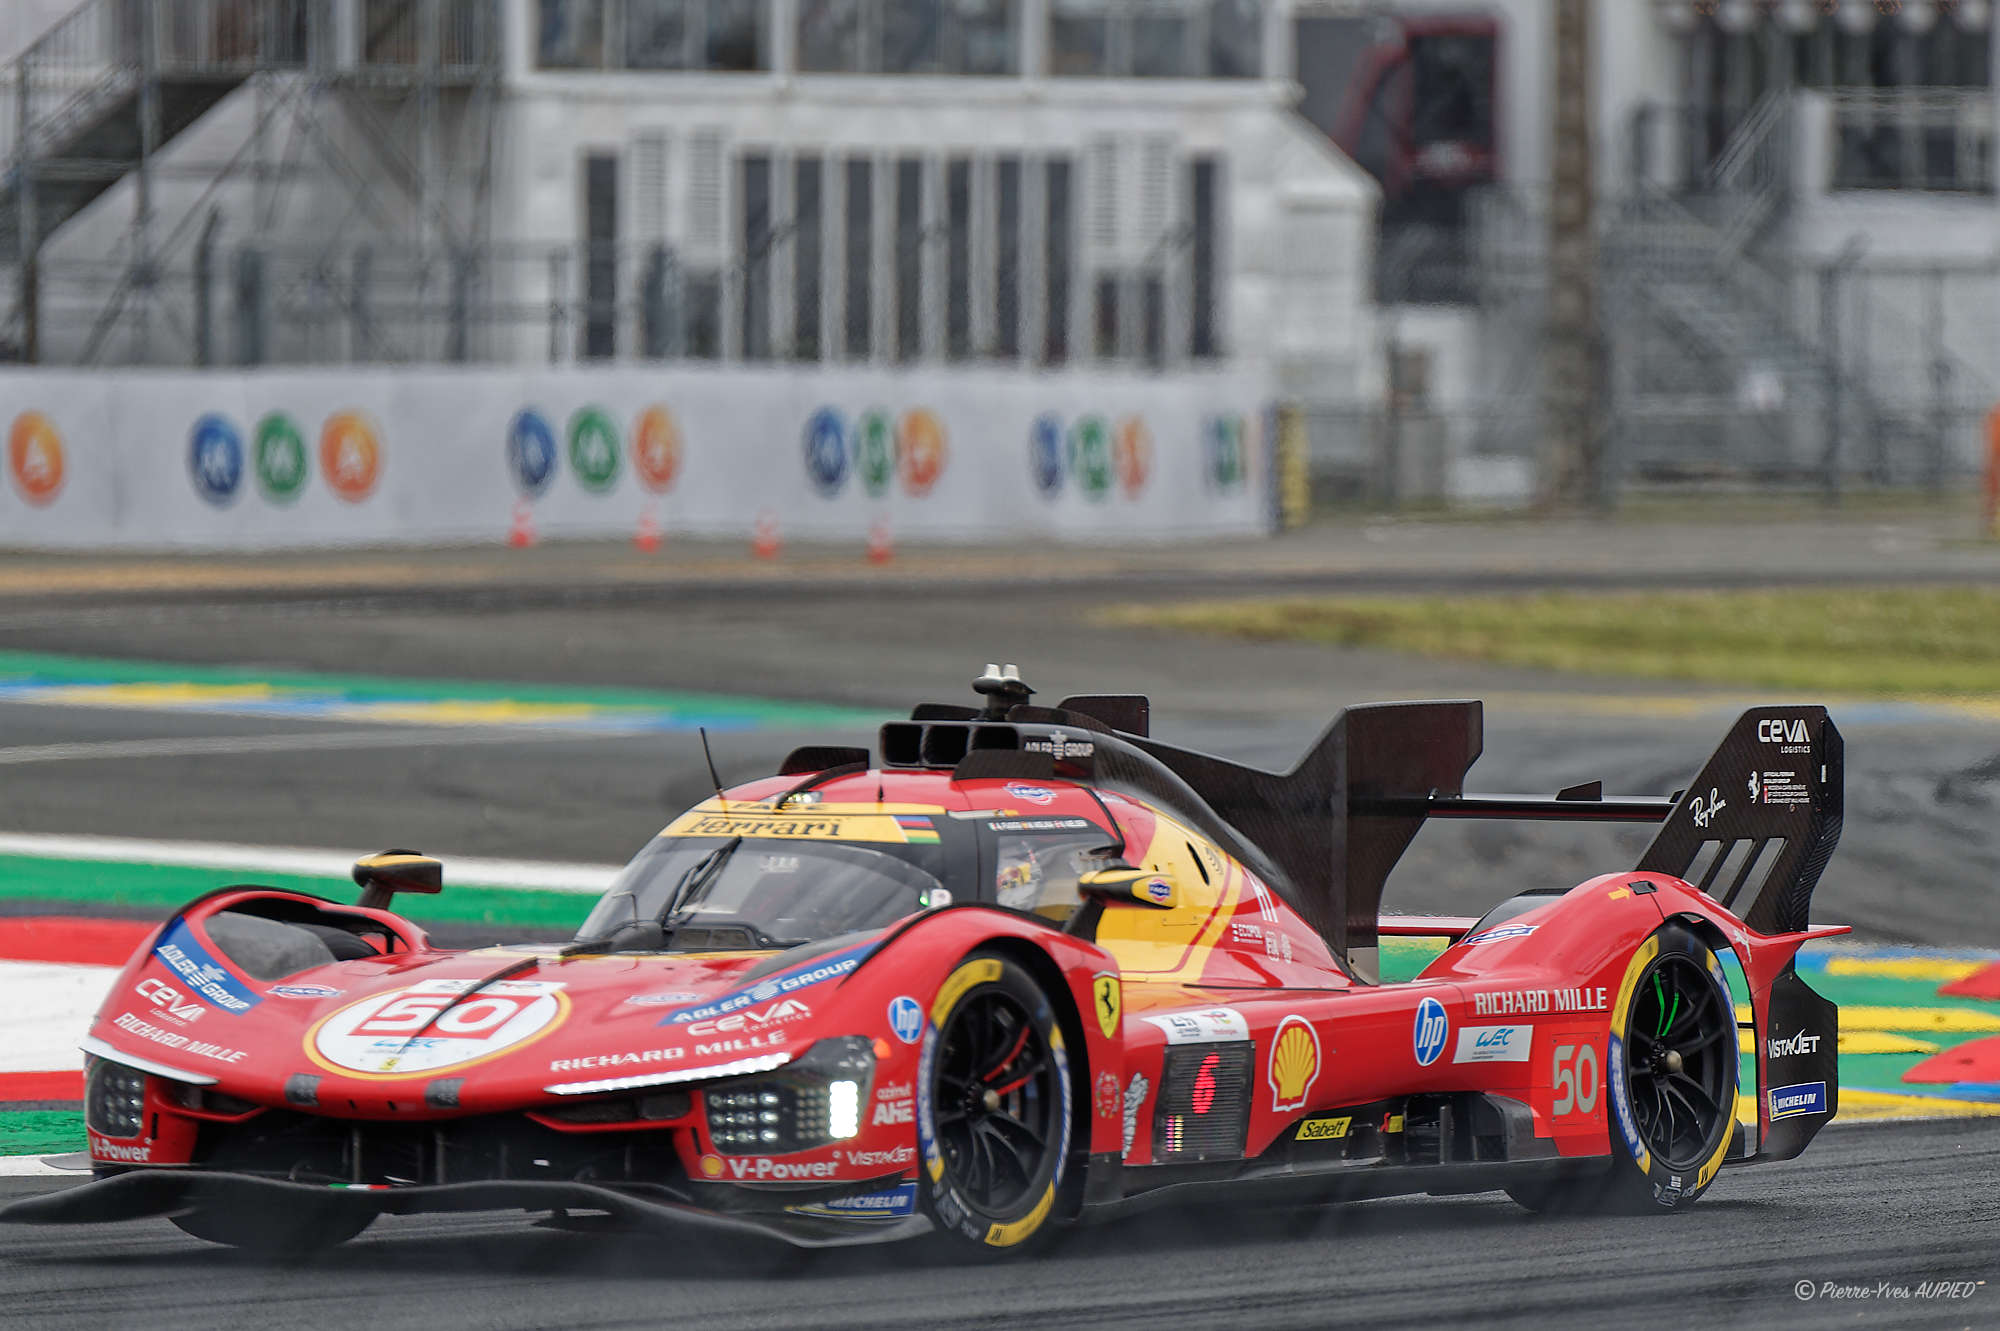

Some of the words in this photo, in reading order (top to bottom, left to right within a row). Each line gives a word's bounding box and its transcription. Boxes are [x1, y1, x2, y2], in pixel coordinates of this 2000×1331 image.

[685, 816, 842, 837] Ferrari
[156, 943, 198, 978] ADLER
[201, 982, 251, 1010] GROUP
[672, 995, 751, 1023] ADLER
[781, 959, 858, 991] GROUP
[360, 996, 520, 1034] 50
[897, 997, 920, 1041] hp
[1474, 989, 1550, 1016] RICHARD
[1554, 987, 1608, 1012] MILLE
[113, 1011, 191, 1048] RICHARD
[183, 1039, 248, 1063] MILLE
[551, 1046, 685, 1073] RICHARD
[695, 1029, 787, 1056] MILLE
[1417, 998, 1445, 1065] hp
[1475, 1028, 1514, 1048] WEC
[1552, 1043, 1599, 1116] 50
[1777, 1093, 1817, 1110] MICHELIN
[1303, 1121, 1344, 1138] Sabelt
[728, 1158, 839, 1179] V-Power
